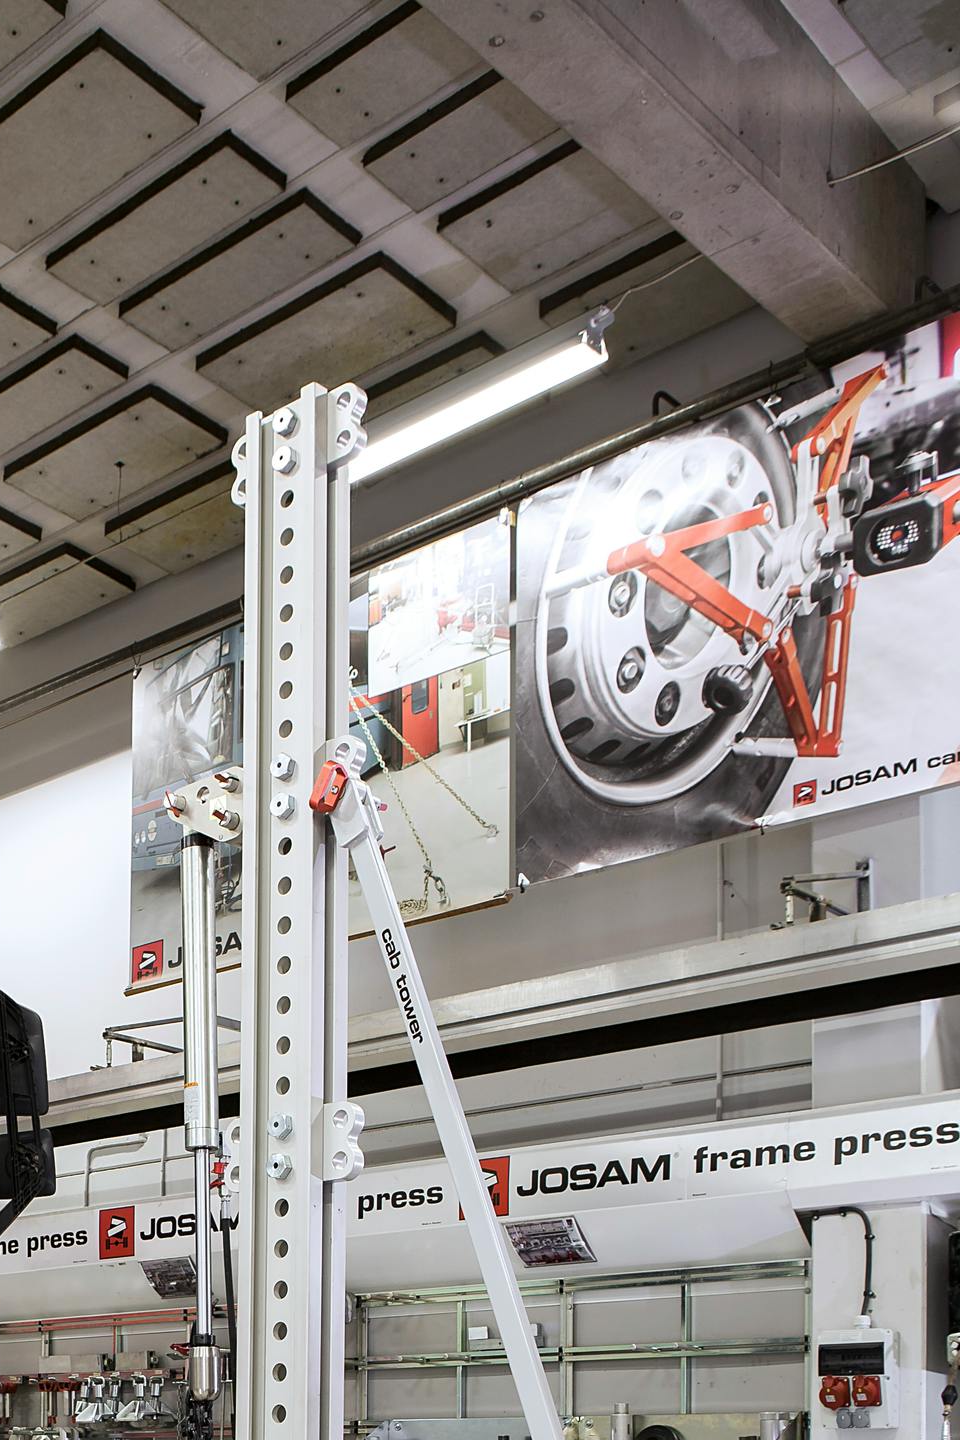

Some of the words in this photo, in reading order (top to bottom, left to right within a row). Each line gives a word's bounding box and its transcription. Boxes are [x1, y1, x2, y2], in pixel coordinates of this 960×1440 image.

[821, 758, 917, 796] JOSAM
[167, 931, 242, 969] JSA
[381, 928, 401, 970] cab
[395, 973, 424, 1044] tower
[693, 1141, 816, 1174] frame
[833, 1122, 960, 1166] press
[516, 1154, 671, 1197] JOSAM
[357, 1186, 444, 1219] press
[26, 1229, 88, 1258] press
